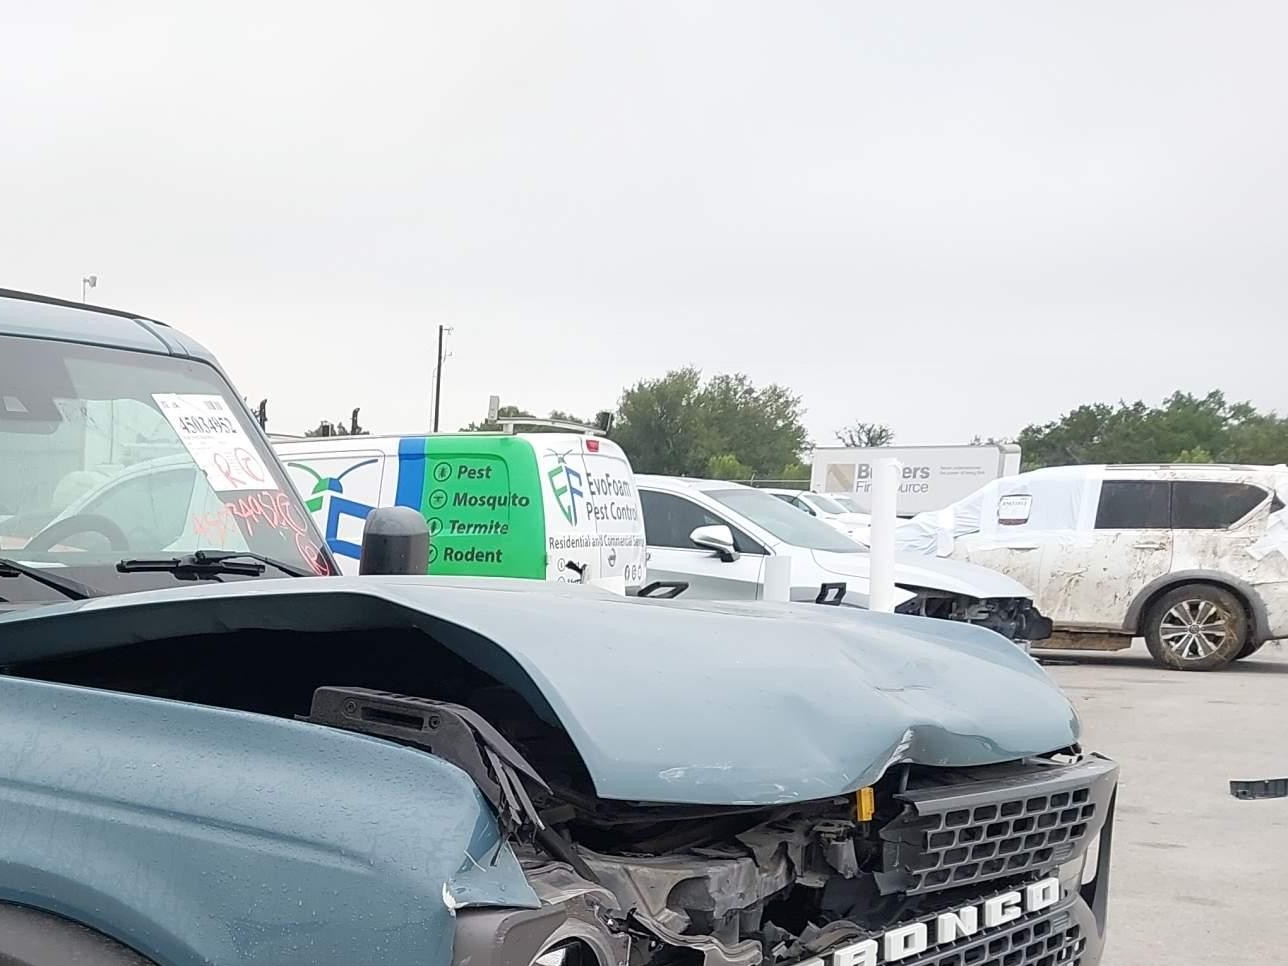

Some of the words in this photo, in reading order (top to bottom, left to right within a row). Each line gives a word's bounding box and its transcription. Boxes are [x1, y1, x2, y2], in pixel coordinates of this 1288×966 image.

[179, 416, 237, 433] 45034952
[457, 465, 492, 479] Pest
[857, 464, 930, 479] Bers
[587, 472, 632, 496] EvoFoam
[856, 481, 929, 493] Firurce
[452, 492, 530, 510] Mosquito
[586, 502, 608, 520] Pest
[610, 502, 637, 520] Control
[449, 520, 509, 535] Termite
[549, 535, 591, 549] Residential
[592, 535, 603, 547] and
[443, 547, 503, 563] Rodent
